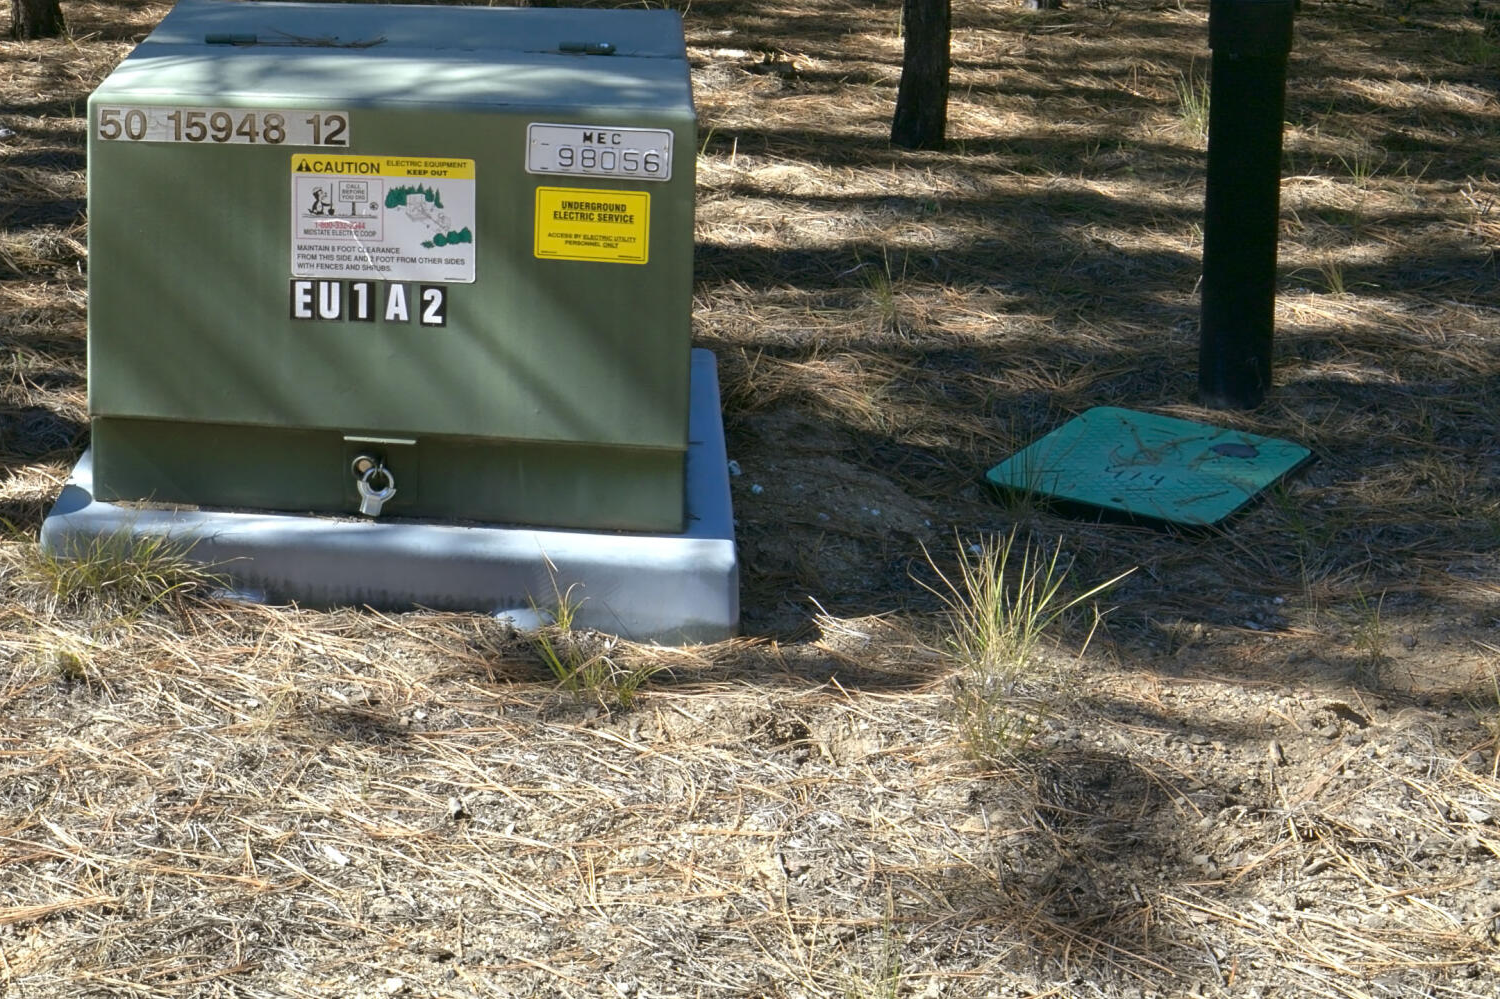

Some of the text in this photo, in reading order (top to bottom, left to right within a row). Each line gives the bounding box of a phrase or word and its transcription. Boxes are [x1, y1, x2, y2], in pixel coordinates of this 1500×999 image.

[99, 109, 347, 145] 50 15948 12
[582, 131, 622, 145] MEC
[386, 160, 467, 169] ELECTRIC EQUIPMENT
[558, 147, 660, 173] 98056
[313, 161, 381, 175] CAUTION
[561, 200, 627, 212] UNDERGROUND
[553, 211, 635, 224] ELECTRIC SERVICE
[303, 229, 331, 237] MIDSTATE
[331, 229, 359, 237] ELECTRC
[582, 234, 613, 242] ELECTRIC
[297, 245, 330, 253] MAINTAIN
[297, 253, 318, 261] FROM
[336, 254, 354, 262] SIDE
[354, 255, 369, 263] AND
[443, 258, 466, 266] SIDES
[316, 263, 344, 271] FENCES
